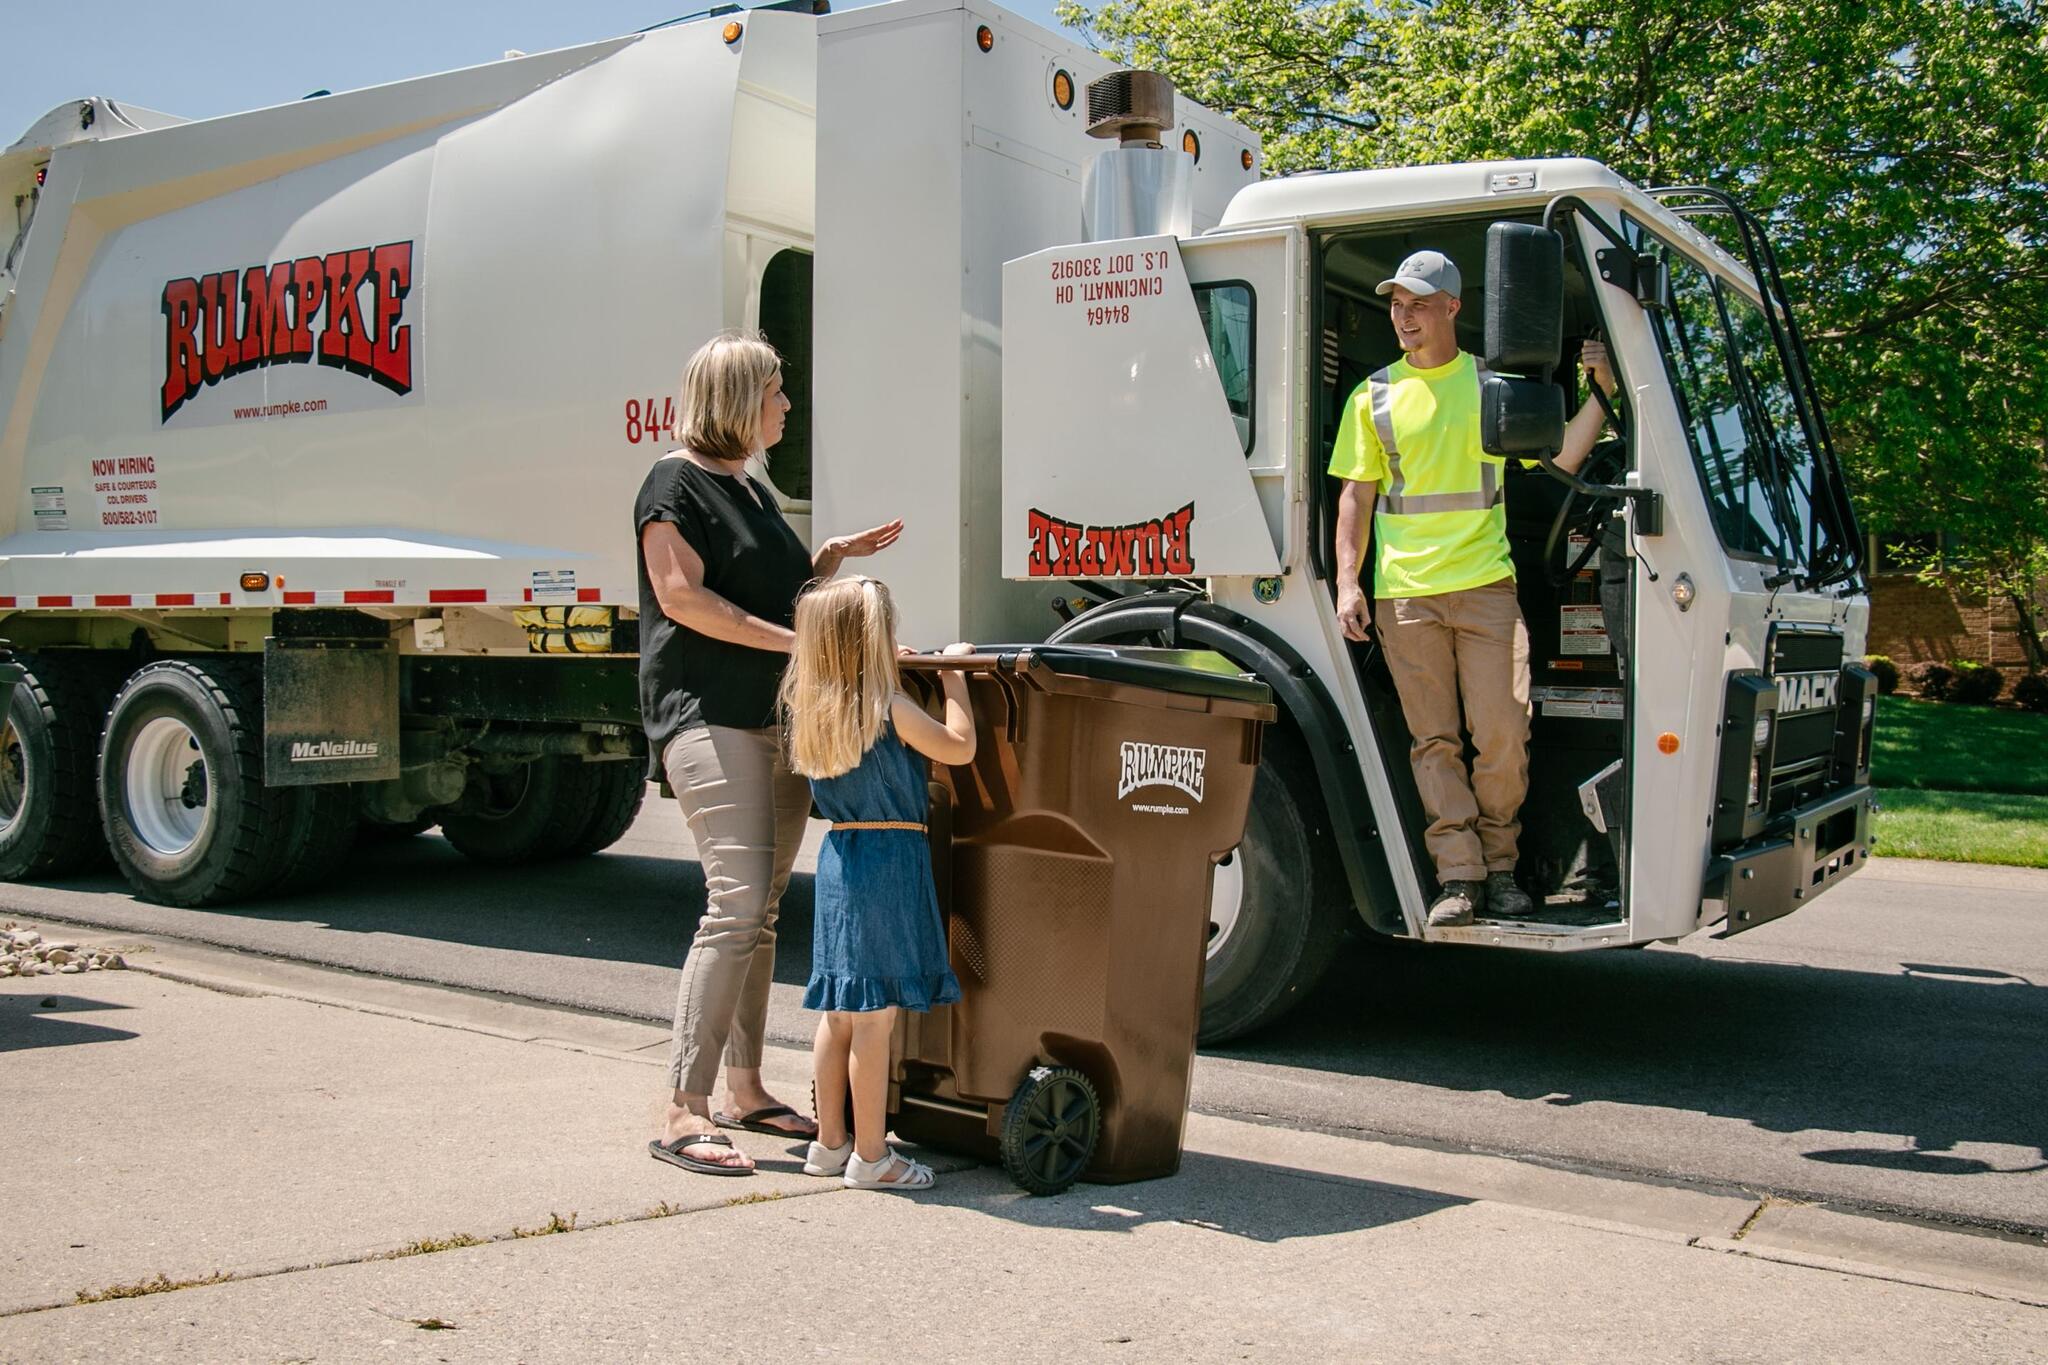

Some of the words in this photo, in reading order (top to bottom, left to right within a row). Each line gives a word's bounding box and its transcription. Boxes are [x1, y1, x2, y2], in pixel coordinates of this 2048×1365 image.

[1051, 258, 1101, 280] 330912
[1107, 255, 1134, 274] DOT
[1140, 251, 1168, 271] U.S.
[1056, 285, 1073, 304] OH
[1080, 277, 1163, 301] CINCINNATI,
[1087, 305, 1130, 326] 84464
[161, 240, 413, 424] RUMPKE
[234, 399, 328, 419] www.rumpke.com
[92, 459, 116, 477] NOW
[118, 456, 155, 475] HIRING
[95, 482, 111, 492] SAFE
[112, 482, 116, 491] &
[117, 480, 157, 491] COURTEOUS
[106, 496, 120, 505] CDL
[121, 494, 148, 504] DRIVERS
[102, 510, 157, 526] 800/582-3107
[1028, 500, 1195, 576] RUMPKE
[1775, 675, 1839, 713] MACK
[291, 741, 378, 758] McNeilus
[1118, 741, 1206, 803] RUMPKE
[1132, 804, 1189, 816] www.rumpke.com
